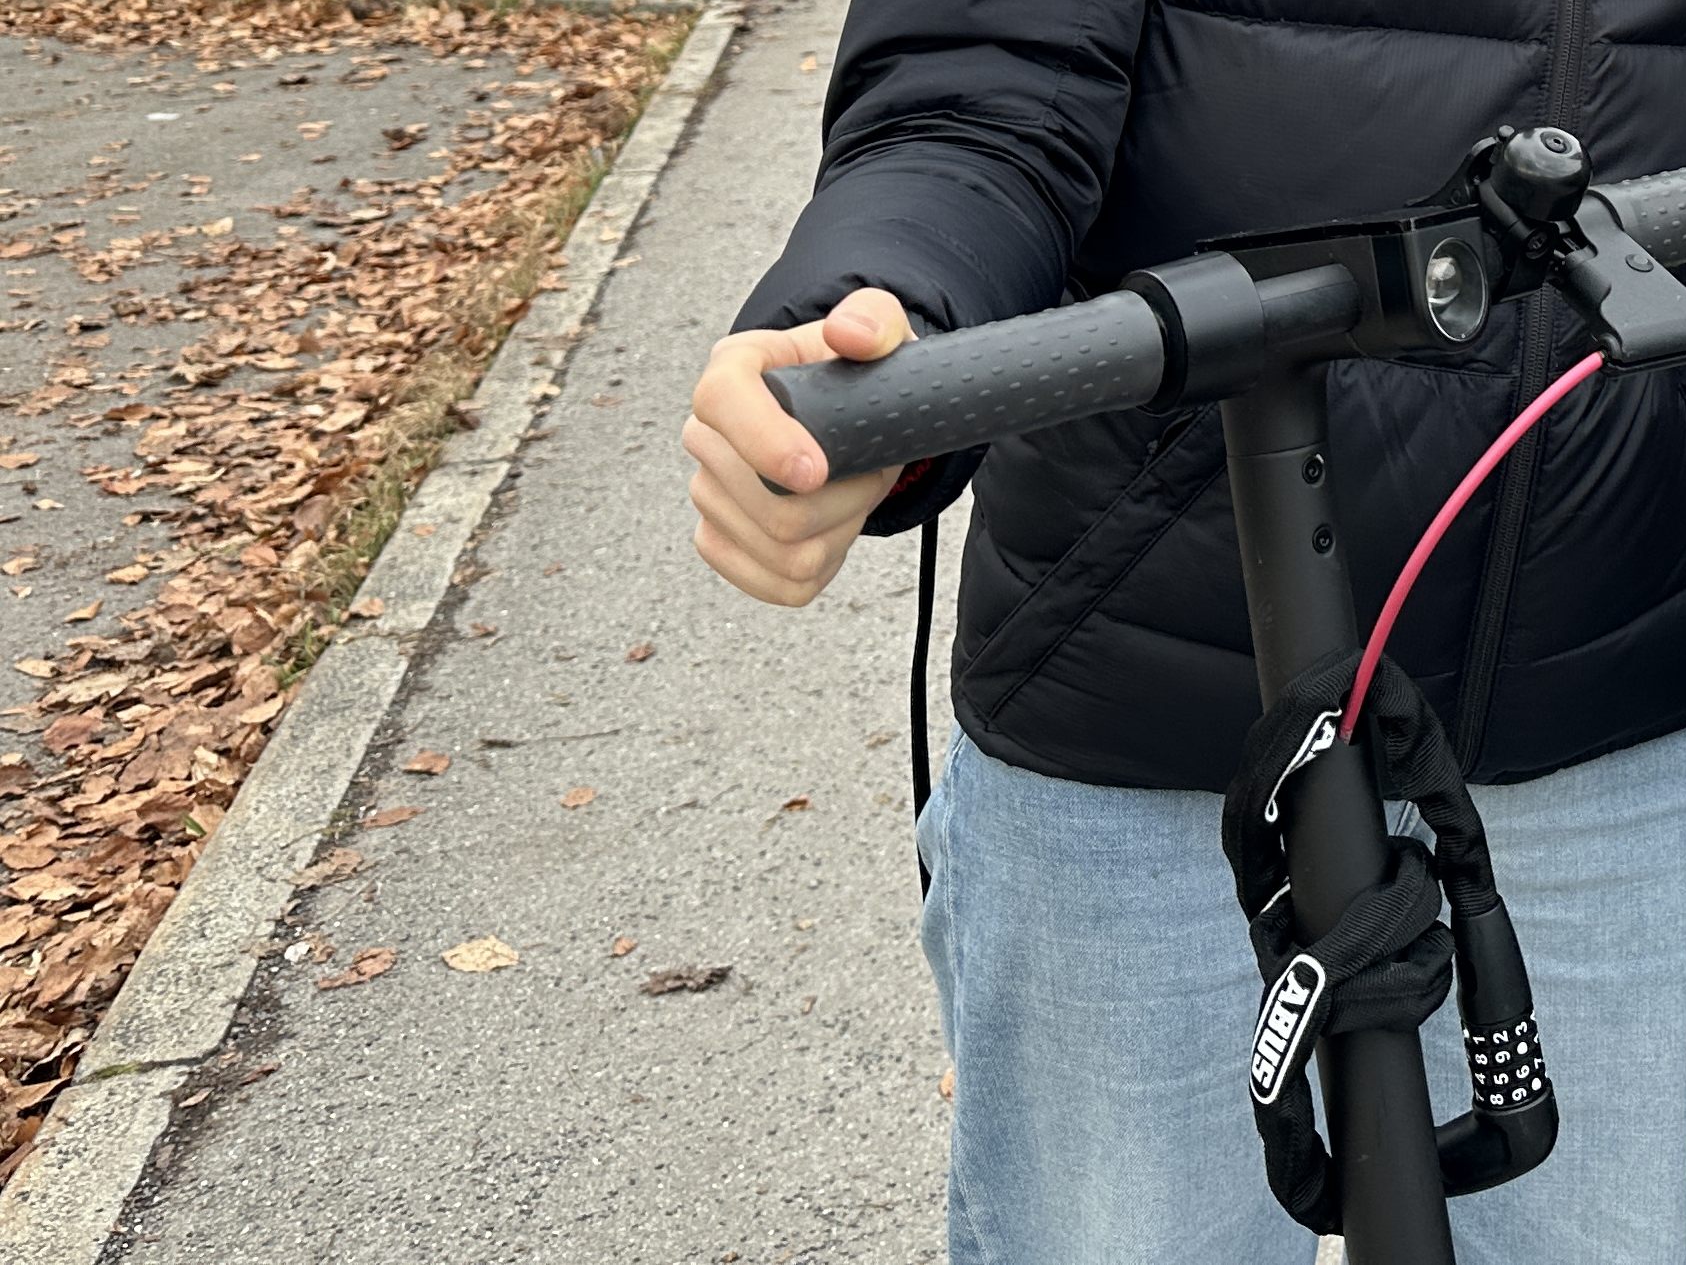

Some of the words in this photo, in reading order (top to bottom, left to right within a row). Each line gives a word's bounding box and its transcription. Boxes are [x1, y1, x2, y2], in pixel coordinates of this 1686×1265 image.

[1251, 970, 1310, 1089] ABUS
[1515, 1021, 1528, 1036] 3
[1493, 1030, 1509, 1044] 2
[1493, 1073, 1509, 1085] 5
[1489, 1093, 1504, 1105] 8
